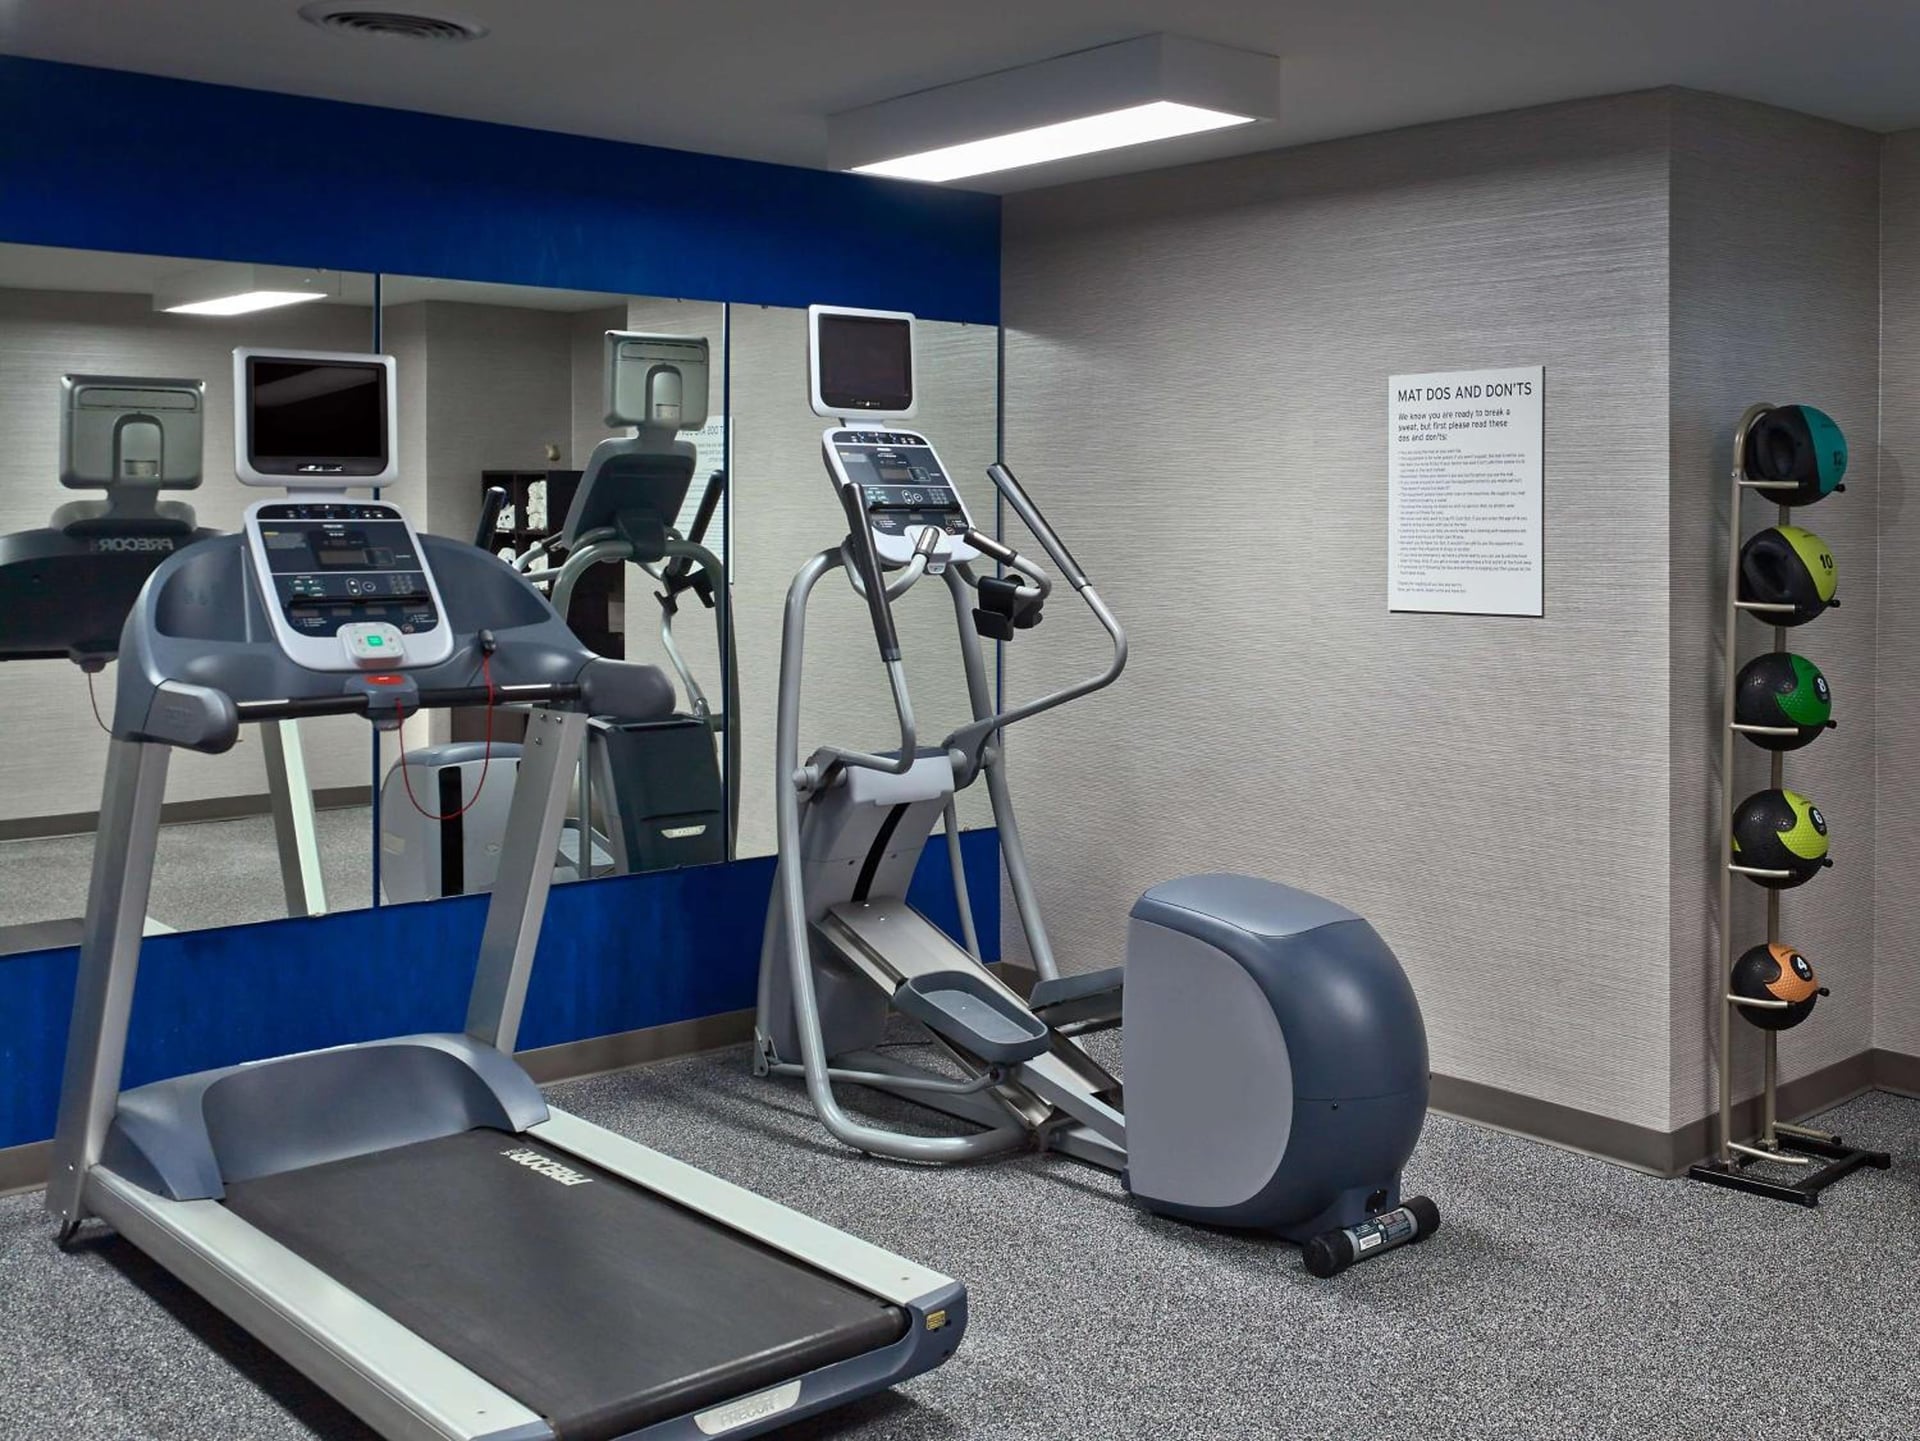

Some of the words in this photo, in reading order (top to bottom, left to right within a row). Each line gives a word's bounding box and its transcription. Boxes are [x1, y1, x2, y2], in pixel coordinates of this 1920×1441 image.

[1398, 388, 1422, 402] MAT
[1426, 387, 1451, 401] DOS
[1455, 385, 1482, 399] AND
[1486, 382, 1532, 398] DON'TS
[1398, 413, 1409, 421] We
[1410, 411, 1426, 420] know
[1428, 412, 1441, 422] you
[1454, 409, 1474, 420] ready
[1475, 409, 1483, 417] to
[1484, 408, 1504, 417] break
[1398, 423, 1419, 432] sweat,
[1420, 422, 1432, 431] but
[1433, 421, 1447, 430] first
[1448, 420, 1470, 430] please
[1471, 420, 1487, 428] read
[1488, 419, 1508, 428] these
[1398, 434, 1410, 442] dos
[1411, 434, 1424, 442] and
[1820, 553, 1833, 569] 10
[1817, 677, 1827, 693] 8
[1813, 809, 1823, 824] 6
[1796, 956, 1808, 970] 4
